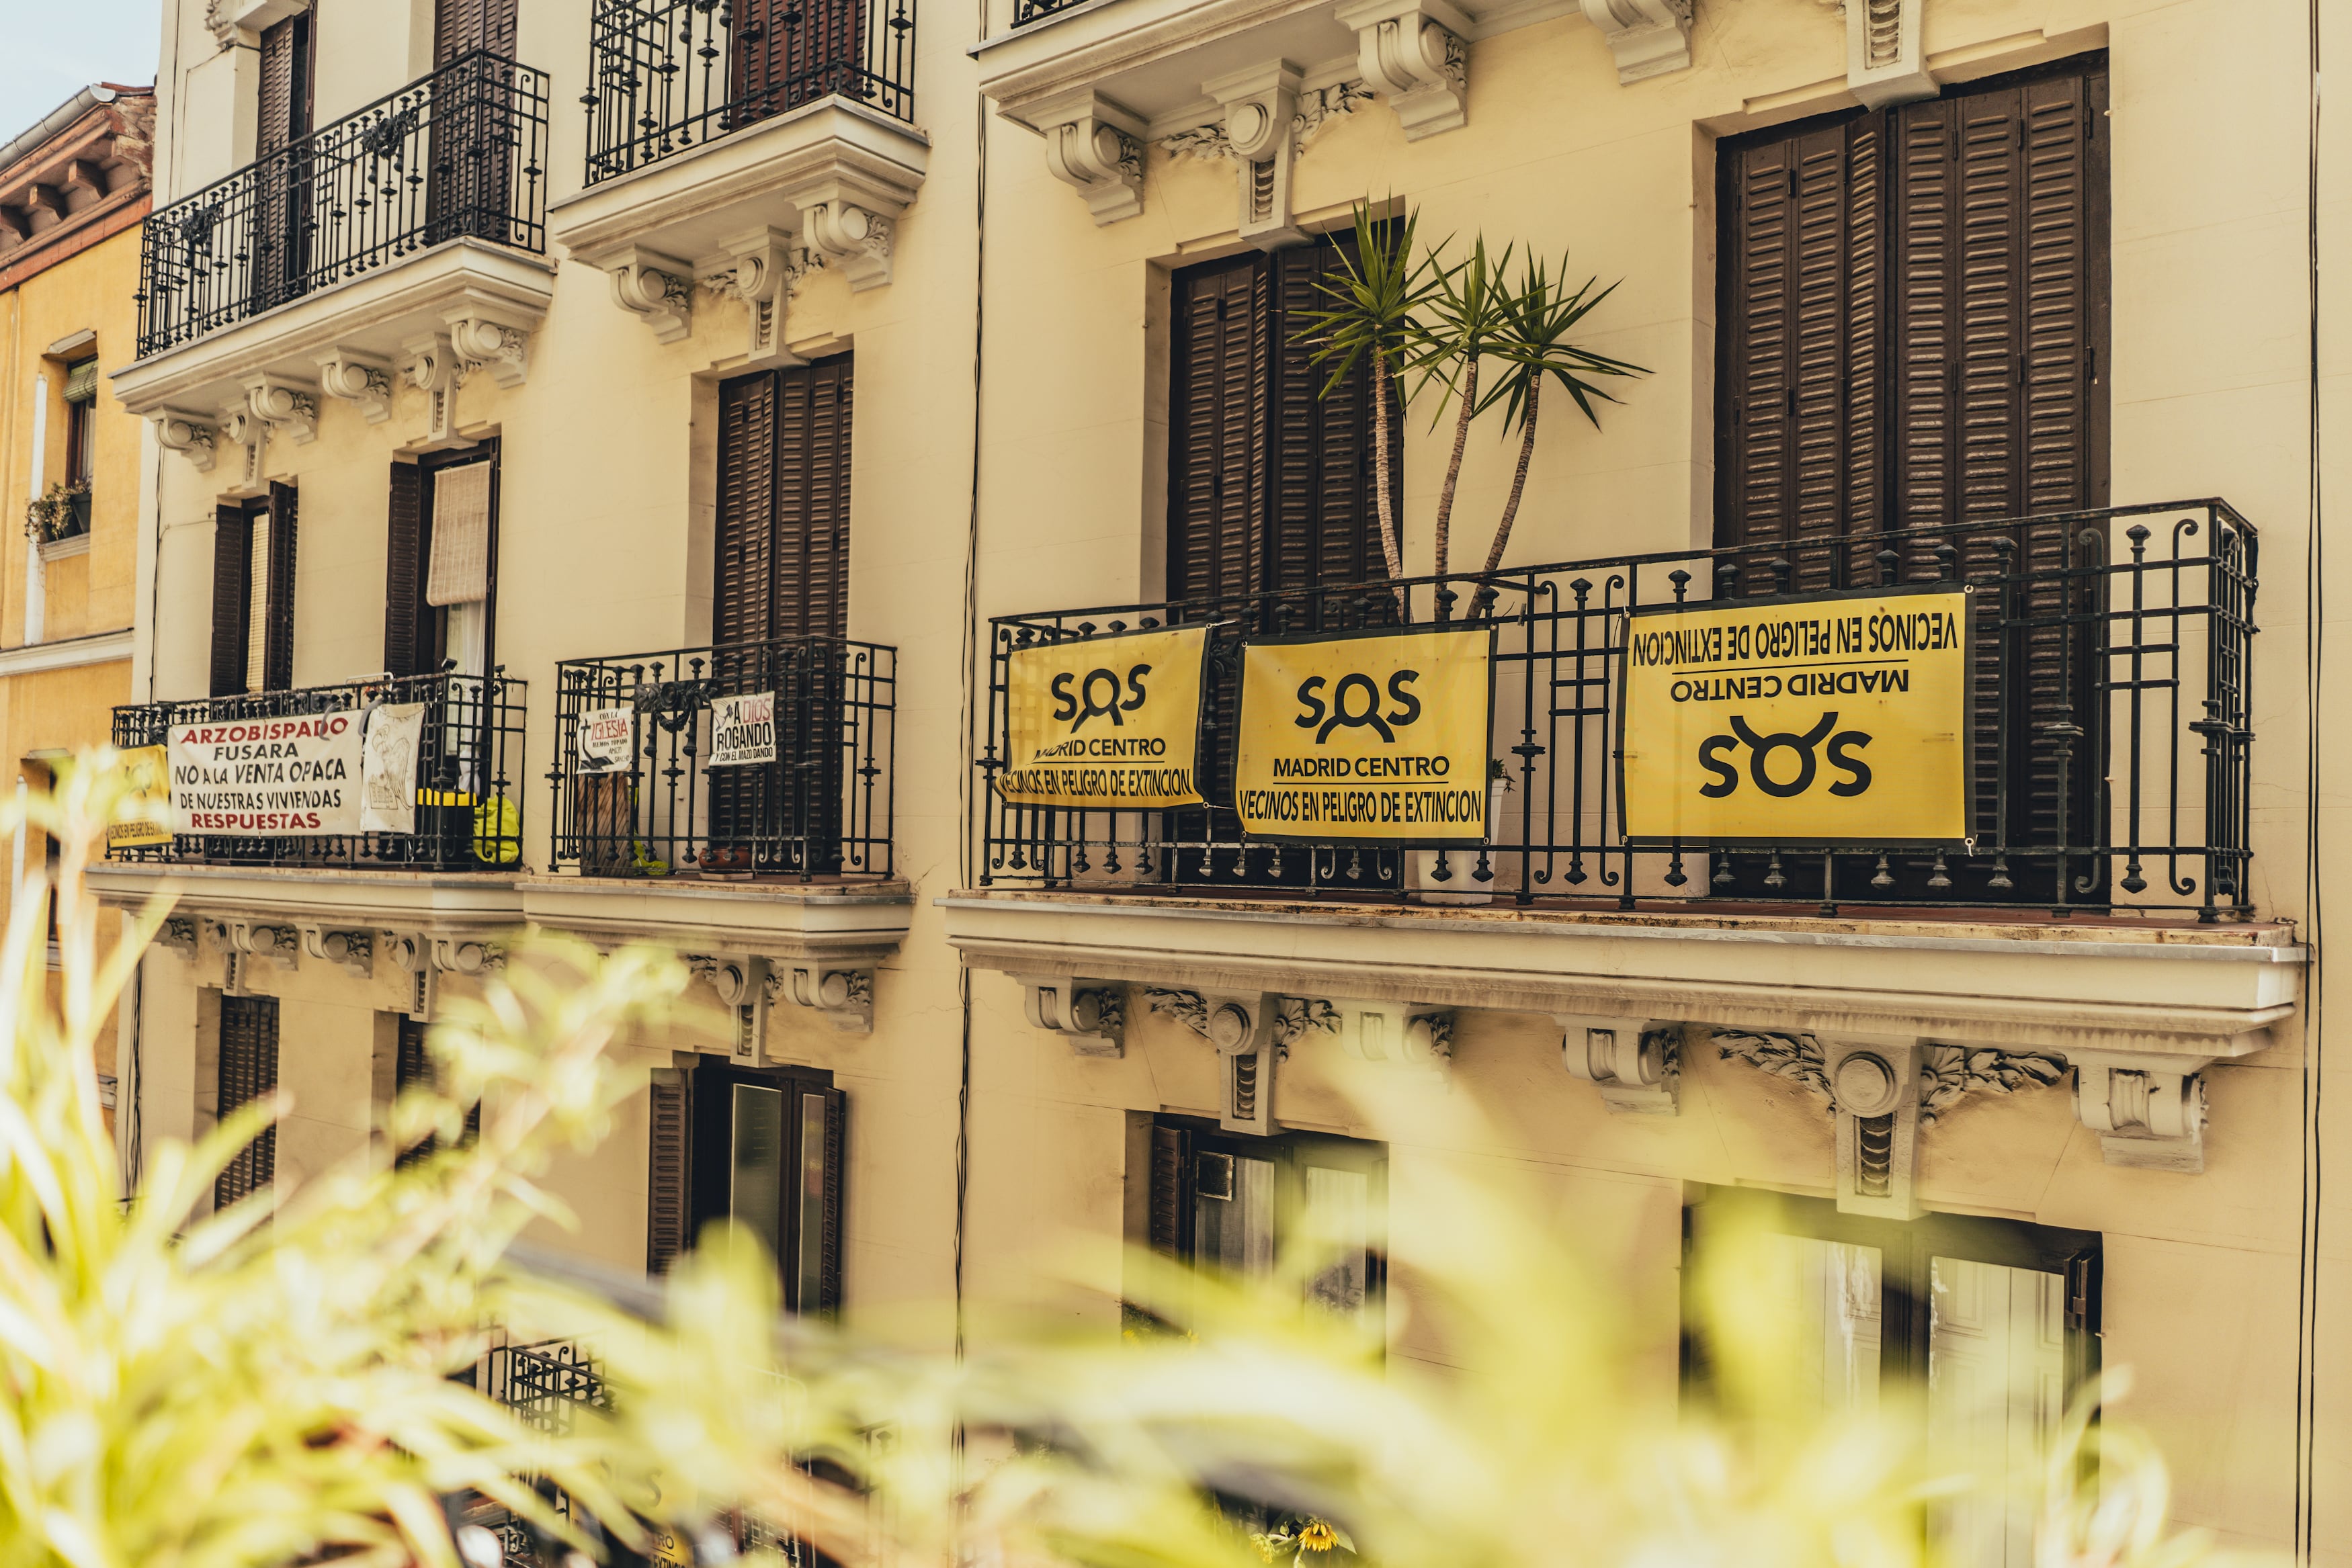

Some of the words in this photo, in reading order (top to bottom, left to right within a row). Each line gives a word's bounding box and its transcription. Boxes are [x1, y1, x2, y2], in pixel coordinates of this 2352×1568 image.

[1728, 625, 1750, 660] DE
[1756, 619, 1831, 658] PELIGRO
[1836, 617, 1862, 654] EN
[1869, 612, 1958, 652] VECINOS
[1633, 627, 1722, 666] EXTINCION
[1670, 675, 1782, 702] CENTRO
[1788, 669, 1909, 696] MADRID
[734, 701, 741, 724] A
[743, 698, 771, 724] DIOS
[1052, 664, 1152, 733] SOS
[1294, 669, 1421, 744] SOS
[181, 717, 349, 744] ARZOBISPADO
[591, 718, 628, 740] IGLESIA
[214, 742, 298, 760] FUSARA
[715, 752, 720, 762] Y
[720, 752, 730, 762] CON
[731, 751, 737, 760] EL
[739, 749, 752, 760] MAZO
[753, 747, 773, 758] DANDO
[1033, 739, 1086, 760] MADRID
[1089, 738, 1166, 756] CENTRO
[1698, 711, 1873, 798] SOS
[175, 765, 199, 785] NO
[203, 769, 210, 785] A
[214, 768, 228, 785] LA
[235, 763, 284, 783] VENTA
[290, 758, 346, 783] OPACA
[1273, 758, 1351, 777] MADRID
[1355, 756, 1450, 777] CENTRO
[999, 769, 1042, 795] VECINOS
[1044, 769, 1062, 795] EN
[1062, 769, 1107, 796] PELIGRO
[1110, 770, 1126, 796] DE
[1129, 768, 1193, 797] EXTINCION
[180, 793, 193, 810] DE
[197, 793, 263, 810] NUESTRAS
[267, 789, 341, 810] VIVIENDAS
[1240, 790, 1298, 821] VECINOS
[1302, 791, 1319, 822] EN
[1323, 791, 1376, 823] PELIGRO
[1381, 791, 1401, 822] DE
[1405, 790, 1481, 823] EXTINCION
[192, 812, 321, 830] RESPUESTAS
